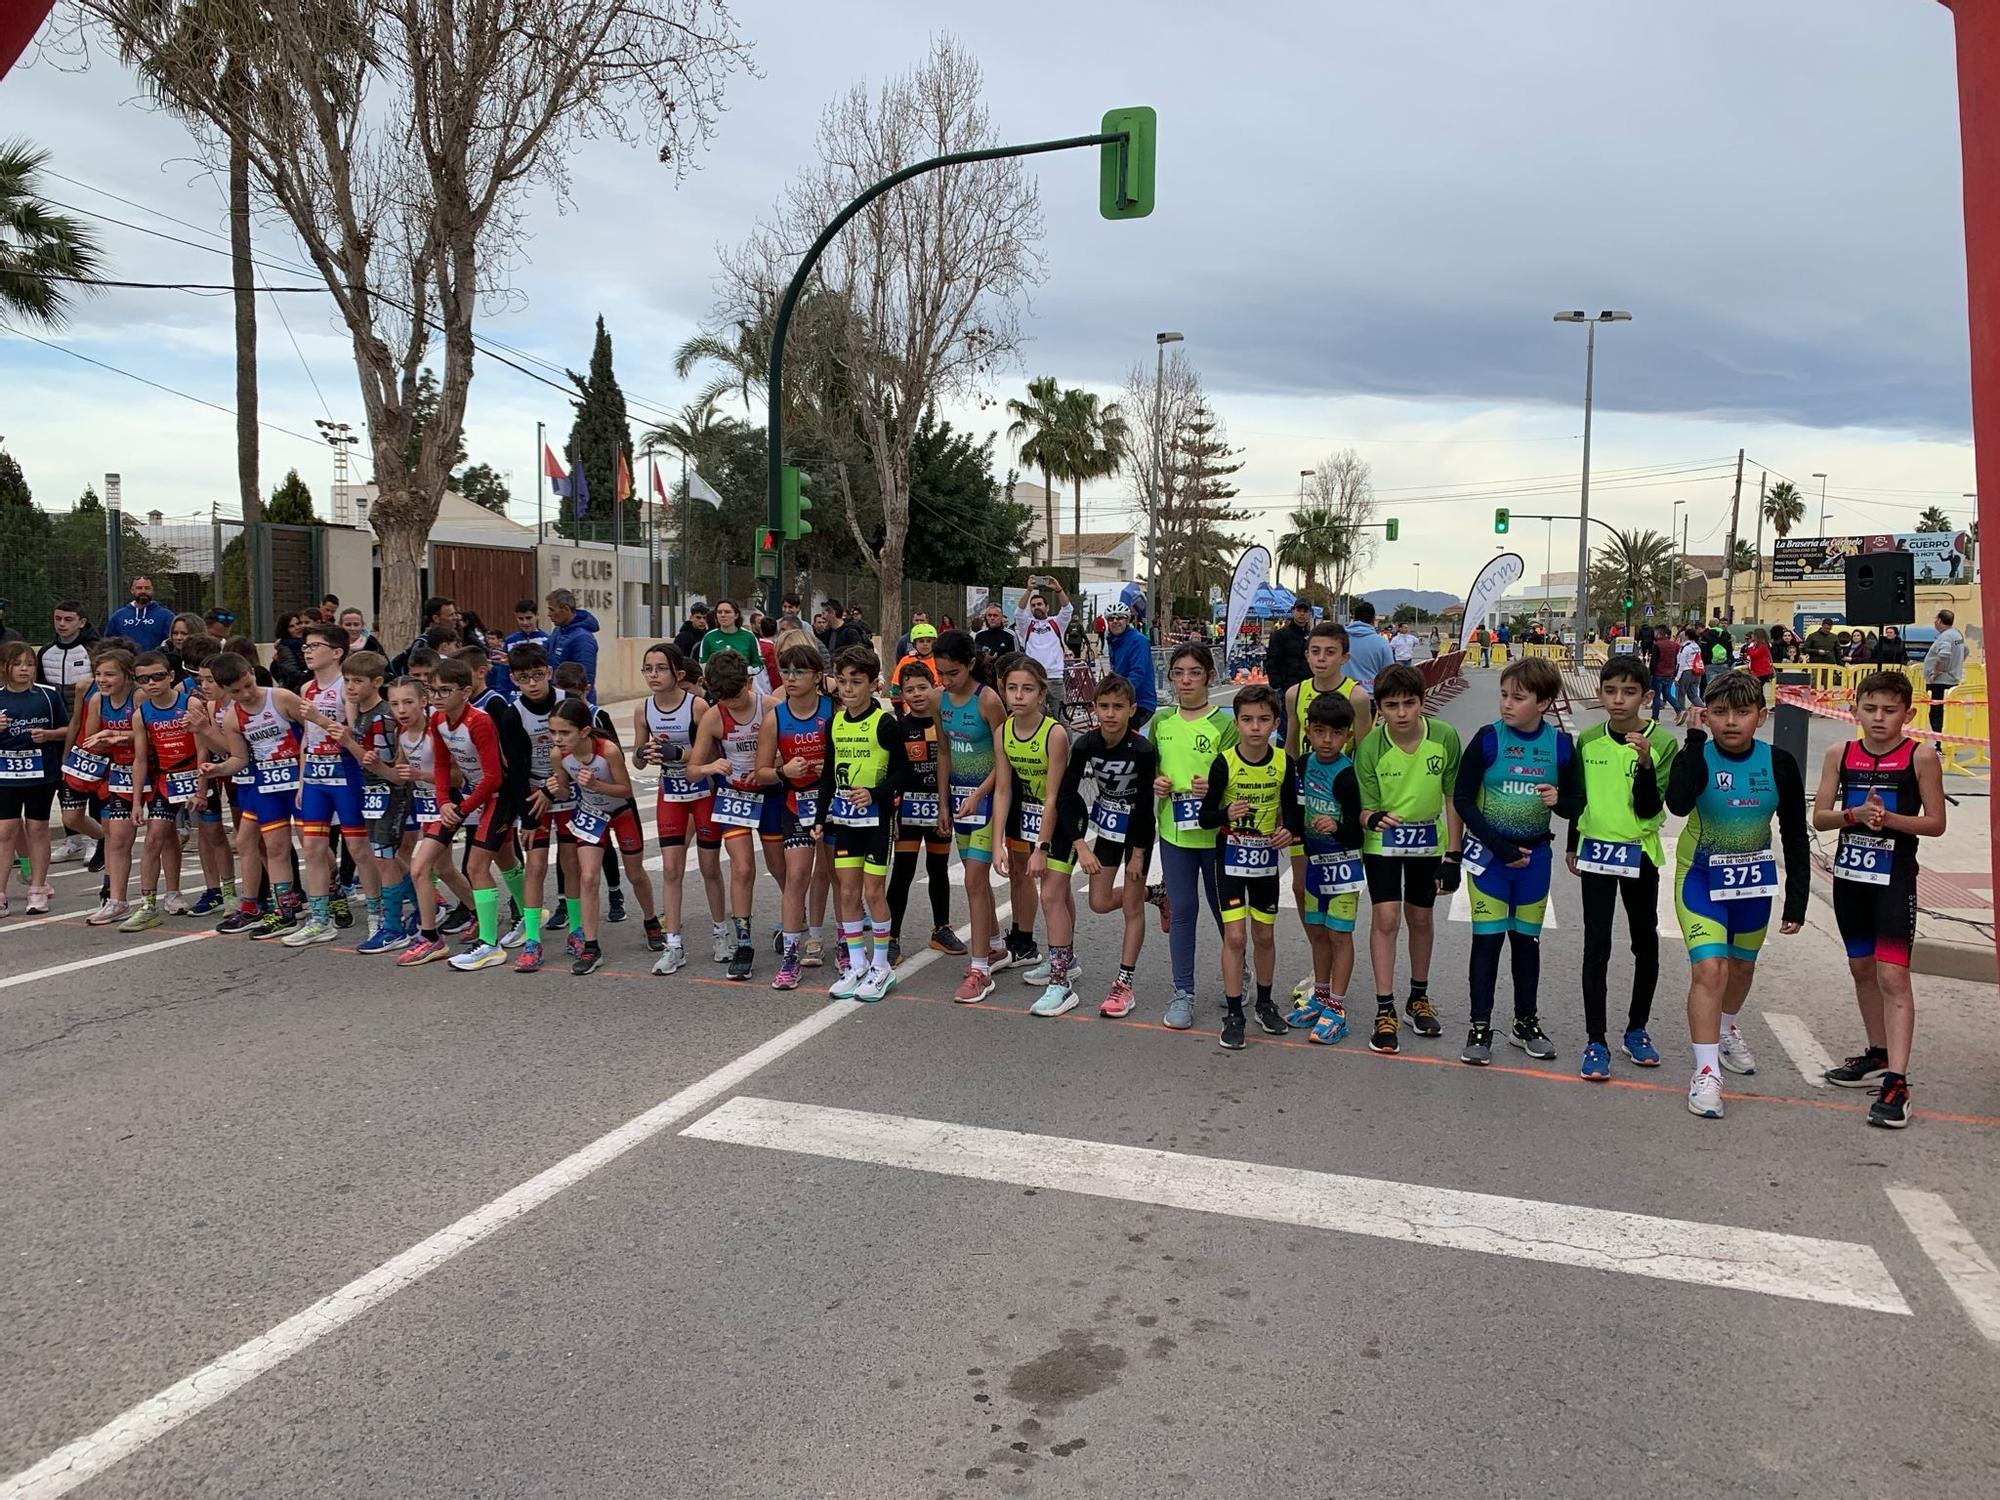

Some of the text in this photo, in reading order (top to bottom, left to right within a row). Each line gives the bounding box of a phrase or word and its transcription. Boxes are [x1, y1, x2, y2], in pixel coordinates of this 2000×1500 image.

[1820, 539, 1829, 547] de
[1909, 540, 1950, 549] CUERPO
[571, 558, 612, 580] CLUB
[571, 589, 612, 609] ENIS
[249, 726, 281, 742] MAIQUEZ
[794, 731, 821, 745] CLOE
[736, 740, 758, 753] NIETO
[6, 758, 34, 771] 338
[73, 756, 98, 774] 360
[311, 764, 336, 777] 367
[262, 768, 291, 784] 366
[722, 798, 752, 817] 365
[912, 802, 939, 817] 363
[1096, 810, 1118, 829] 76
[1394, 828, 1427, 845] 372
[1236, 848, 1270, 865] 380
[1591, 842, 1628, 863] 374
[1839, 846, 1877, 869] 356
[1322, 863, 1352, 883] 370
[1723, 864, 1762, 886] 375
